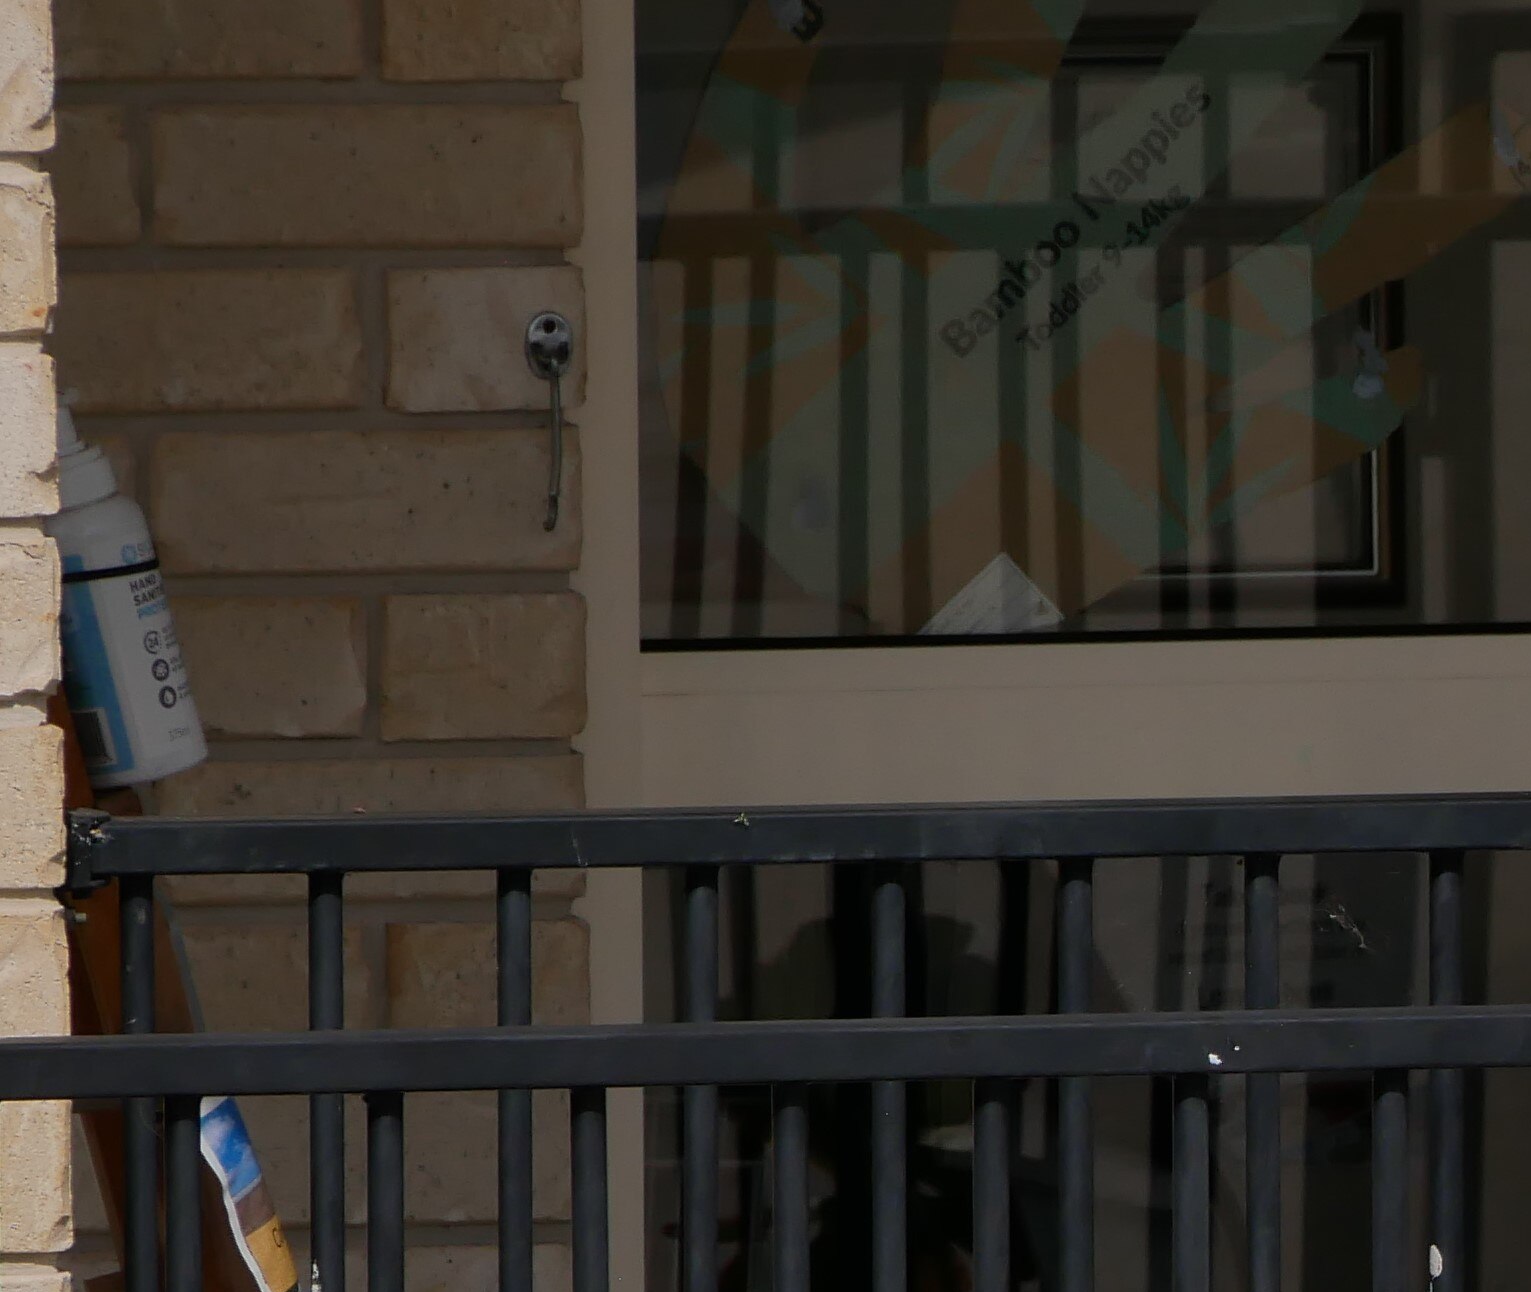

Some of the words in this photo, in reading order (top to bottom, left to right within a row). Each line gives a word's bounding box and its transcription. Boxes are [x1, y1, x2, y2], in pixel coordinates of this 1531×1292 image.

[938, 220, 1081, 359] Bamboo
[1071, 84, 1212, 222] Nappies
[1015, 264, 1105, 352] Toddler
